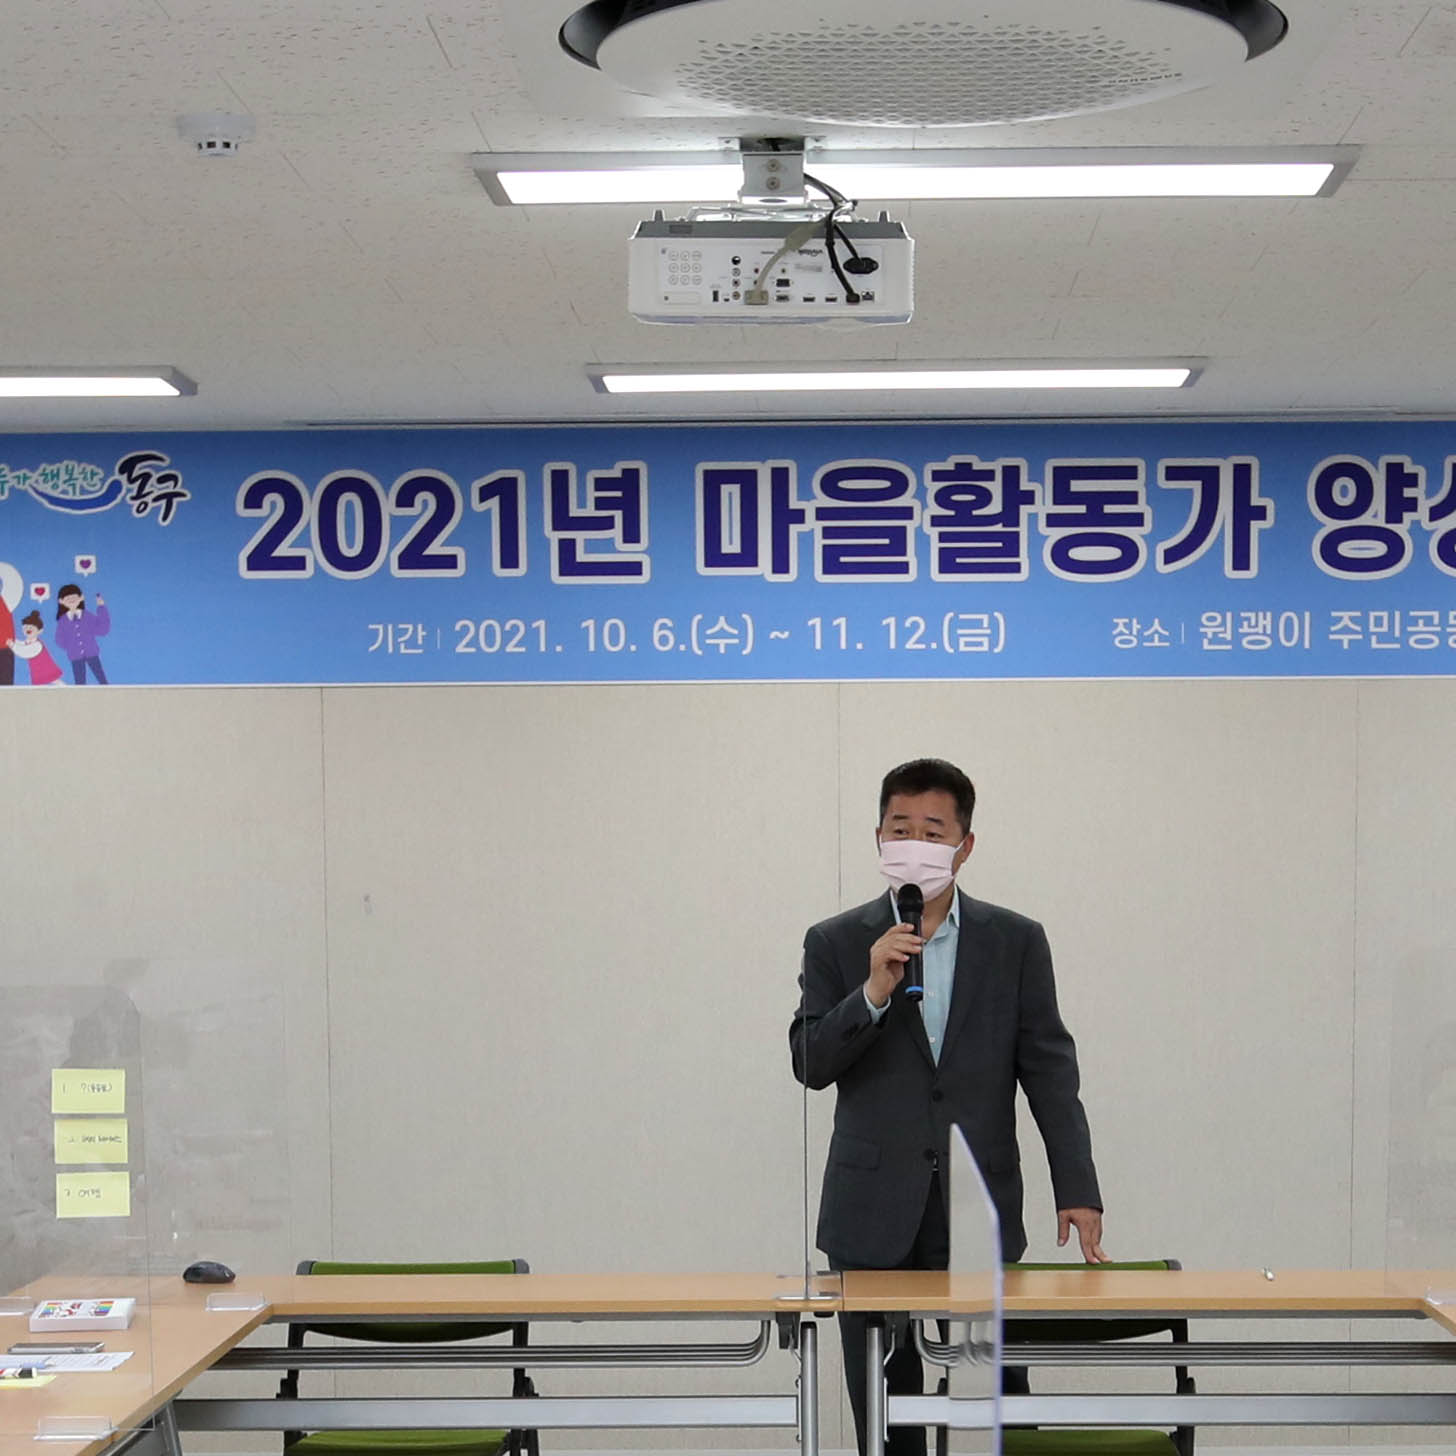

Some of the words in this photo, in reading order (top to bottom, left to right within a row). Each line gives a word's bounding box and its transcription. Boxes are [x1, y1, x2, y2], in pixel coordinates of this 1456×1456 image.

[117, 451, 190, 522] 동구
[238, 465, 651, 581] 2021년
[698, 461, 1270, 580] 마을활동가
[367, 622, 426, 655] 기간
[455, 619, 562, 653] 2021.
[581, 618, 636, 652] 10.
[807, 617, 863, 650] 11.
[882, 611, 1006, 654] 12.(금)
[1112, 617, 1170, 649] 장소
[1199, 611, 1311, 651] 원괭이
